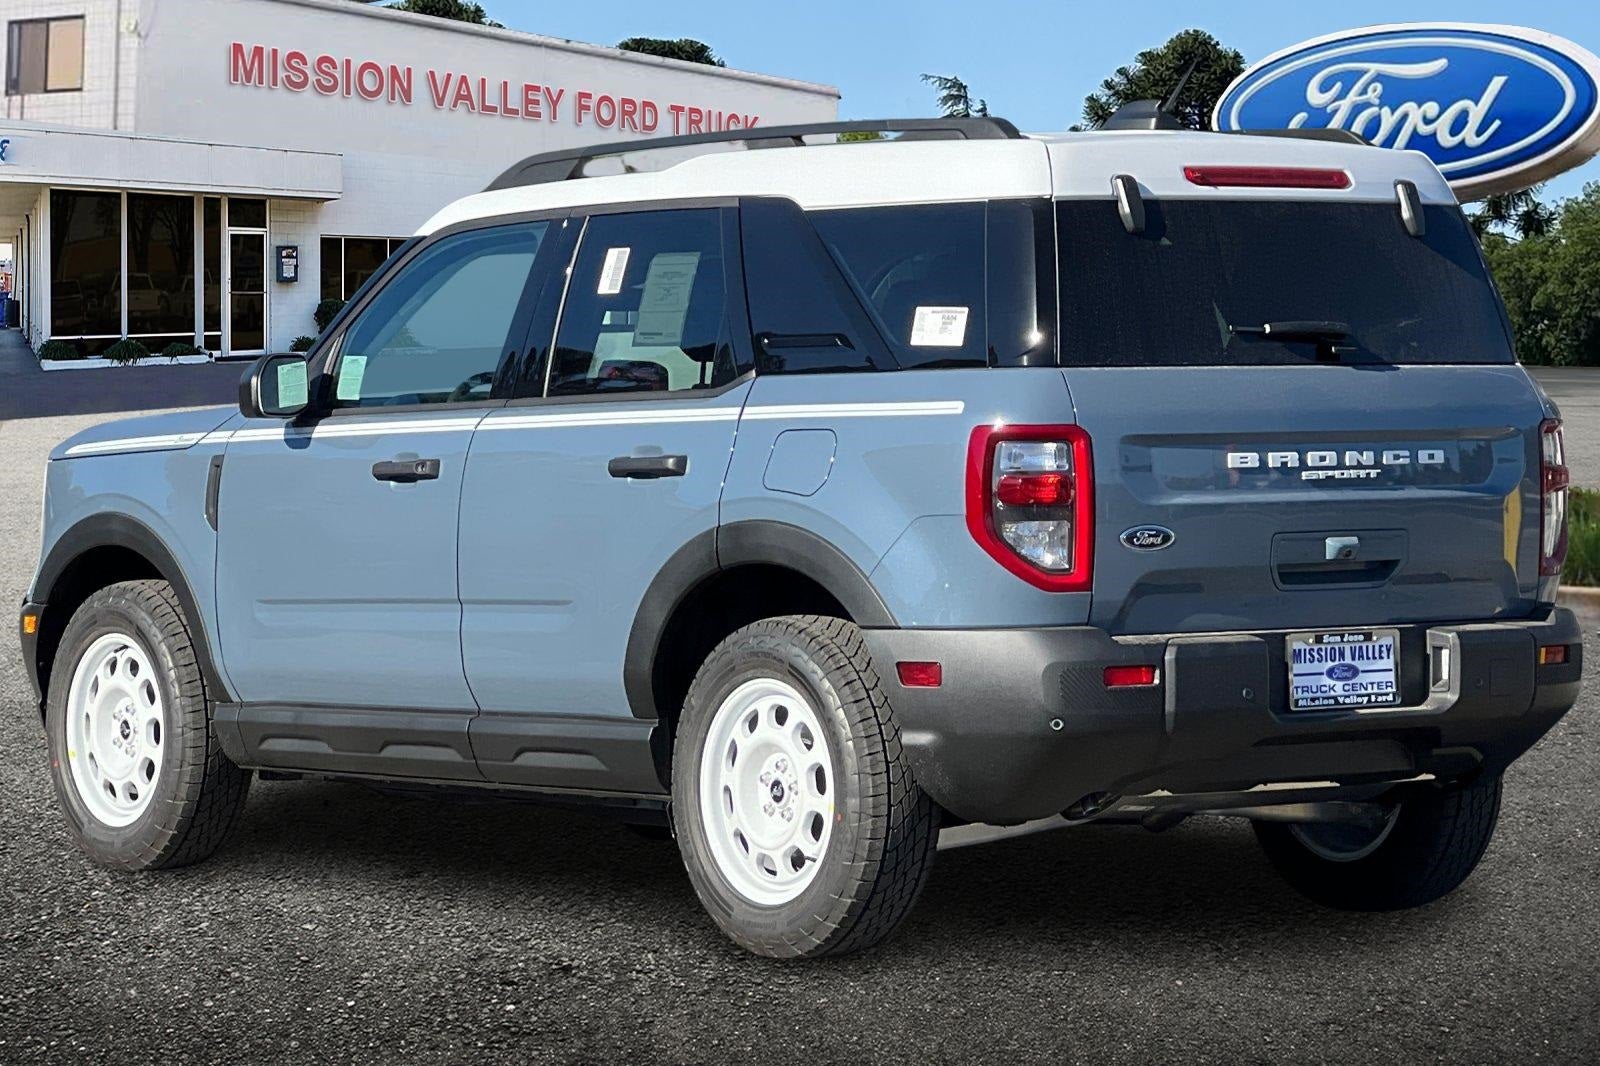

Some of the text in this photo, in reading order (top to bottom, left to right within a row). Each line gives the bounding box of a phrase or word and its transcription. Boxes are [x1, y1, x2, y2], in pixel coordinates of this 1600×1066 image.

[230, 41, 414, 104] MISSION
[426, 69, 566, 122] VALLEY
[576, 90, 660, 134] FORD
[1288, 57, 1508, 150] Ford
[1226, 449, 1446, 469] BRONCO
[1301, 469, 1382, 481] SPORT
[1133, 530, 1164, 545] Ford
[1292, 643, 1393, 664] MISSION VALLEY
[1332, 666, 1355, 679] Ford
[1293, 681, 1395, 695] TRUCK CENTER
[1337, 695, 1369, 705] Valley
